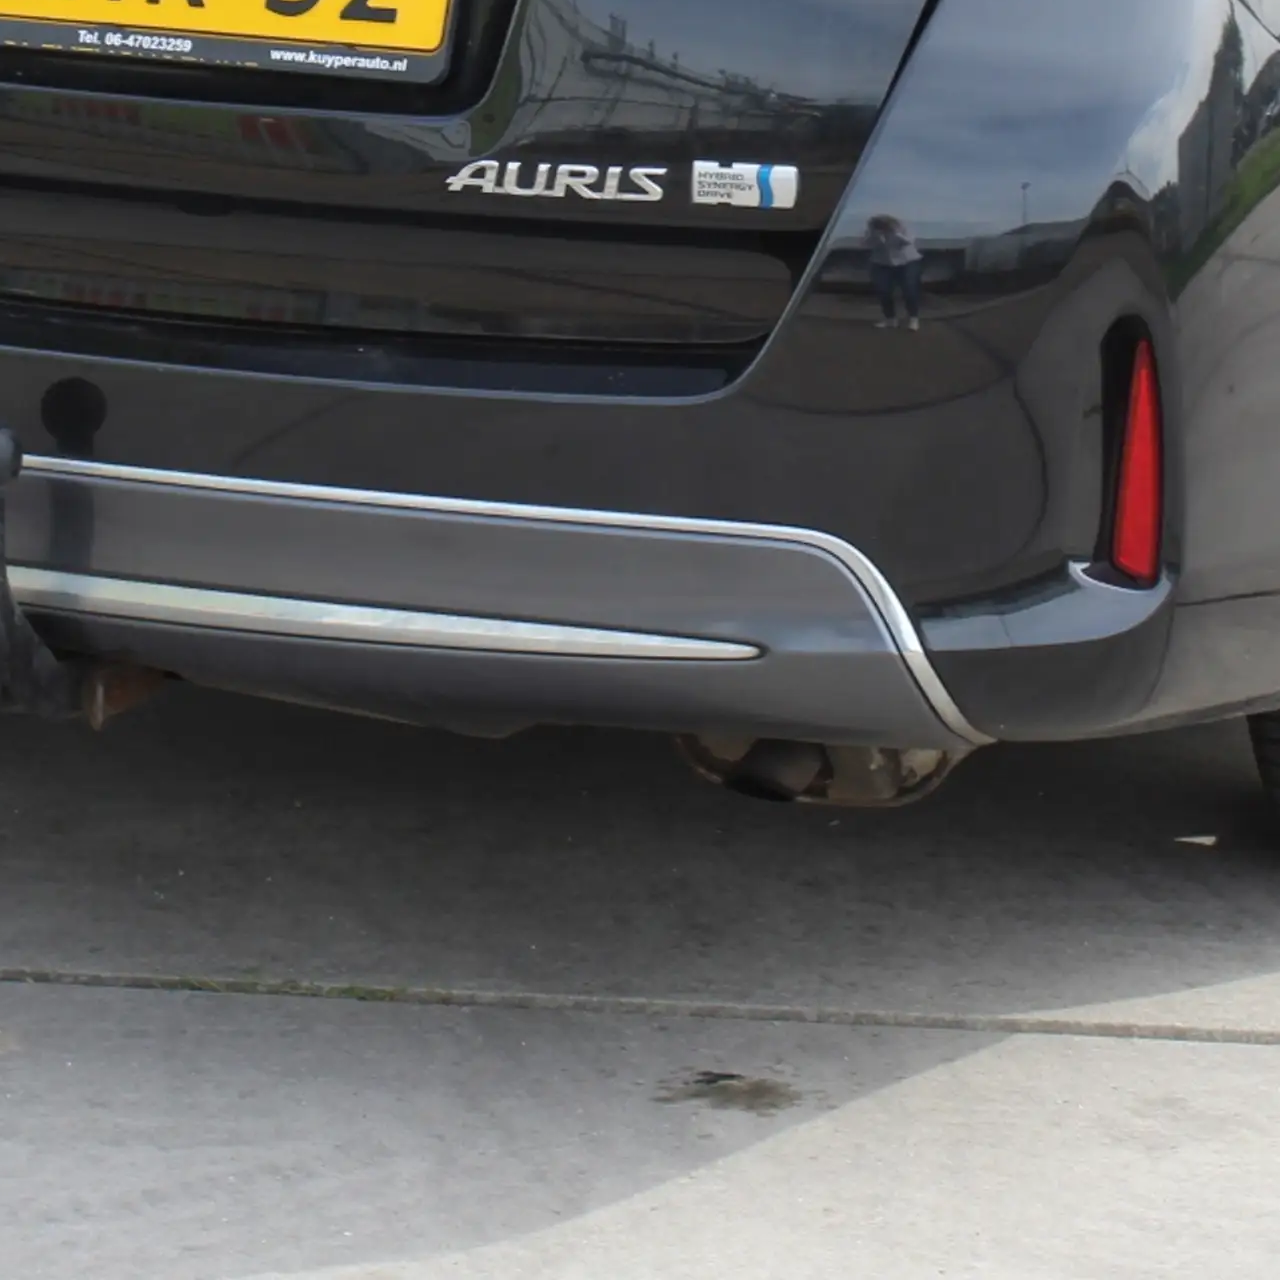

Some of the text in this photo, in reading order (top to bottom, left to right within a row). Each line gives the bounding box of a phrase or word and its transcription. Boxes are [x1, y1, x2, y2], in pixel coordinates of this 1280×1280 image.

[77, 29, 101, 46] Tel.
[104, 31, 193, 53] 06-47023259
[270, 47, 408, 72] www.kuyperauto.nl
[444, 159, 668, 202] AURIS
